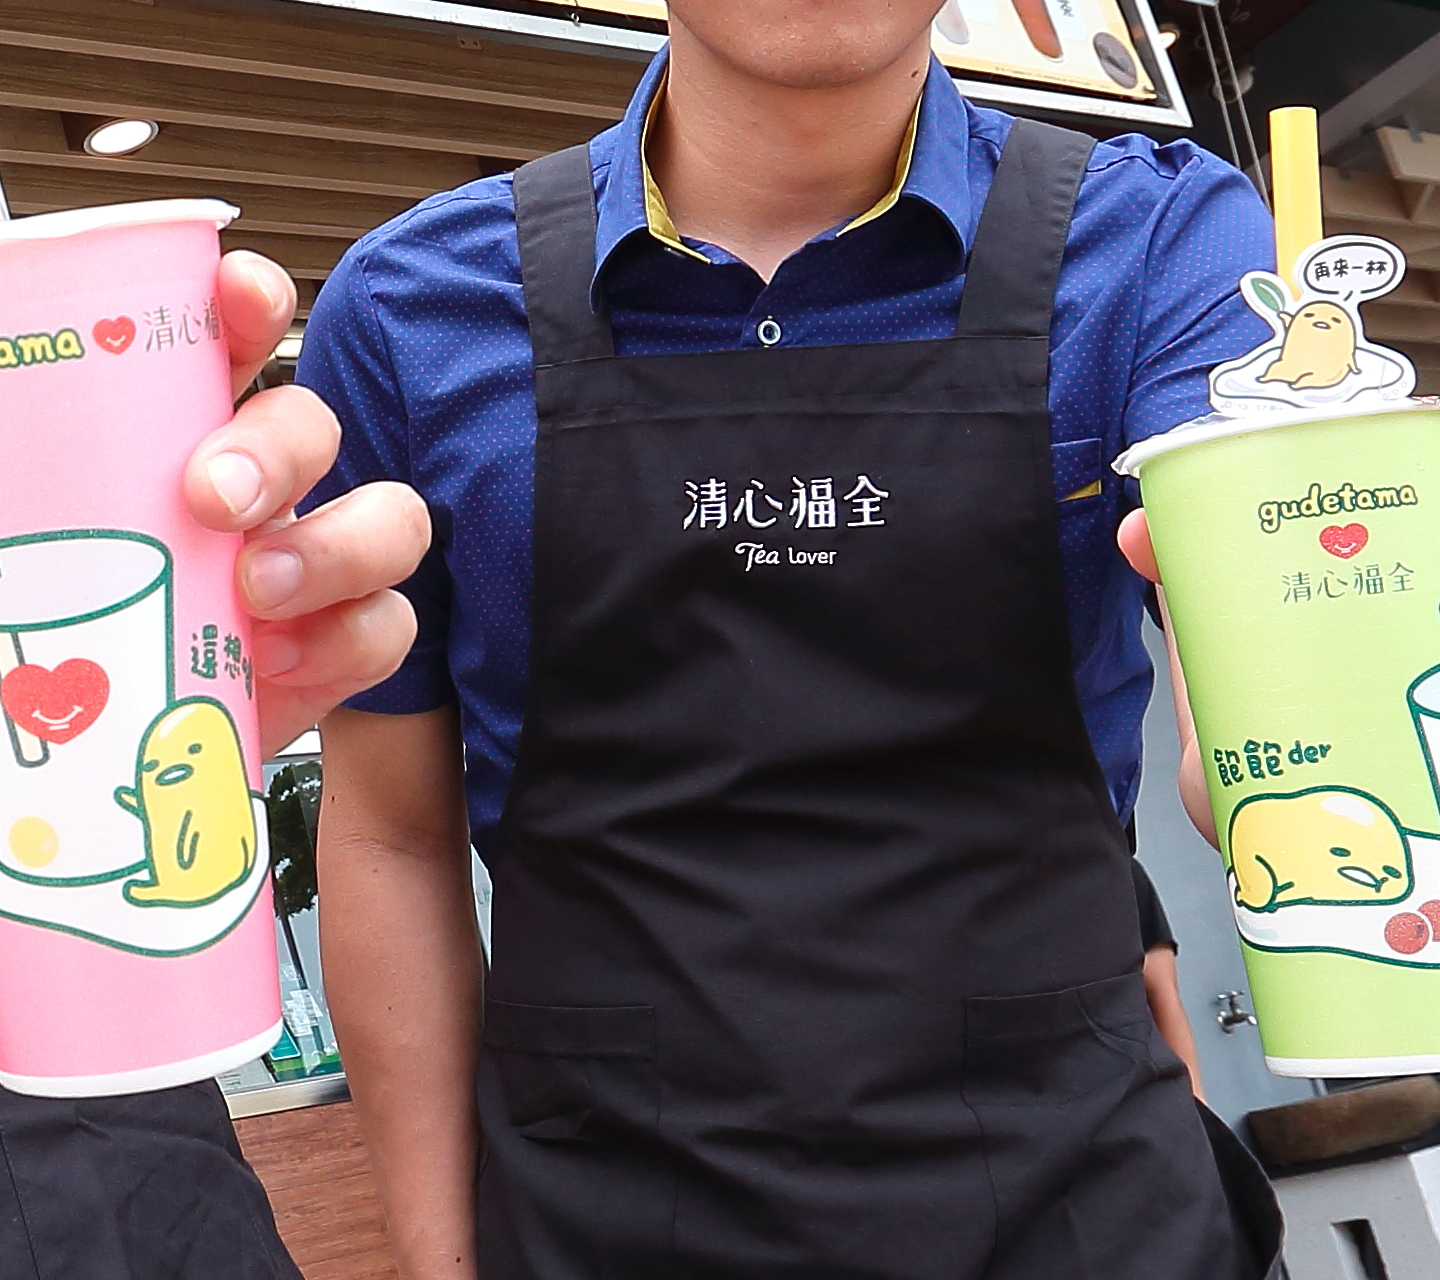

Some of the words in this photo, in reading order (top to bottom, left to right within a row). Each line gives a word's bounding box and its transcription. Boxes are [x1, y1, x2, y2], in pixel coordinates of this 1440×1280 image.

[1314, 258, 1387, 281] 再來一杯
[683, 475, 889, 529] 清心福全
[1258, 483, 1418, 534] gudetama
[735, 542, 780, 571] Tea
[1281, 560, 1415, 604] 清心福全
